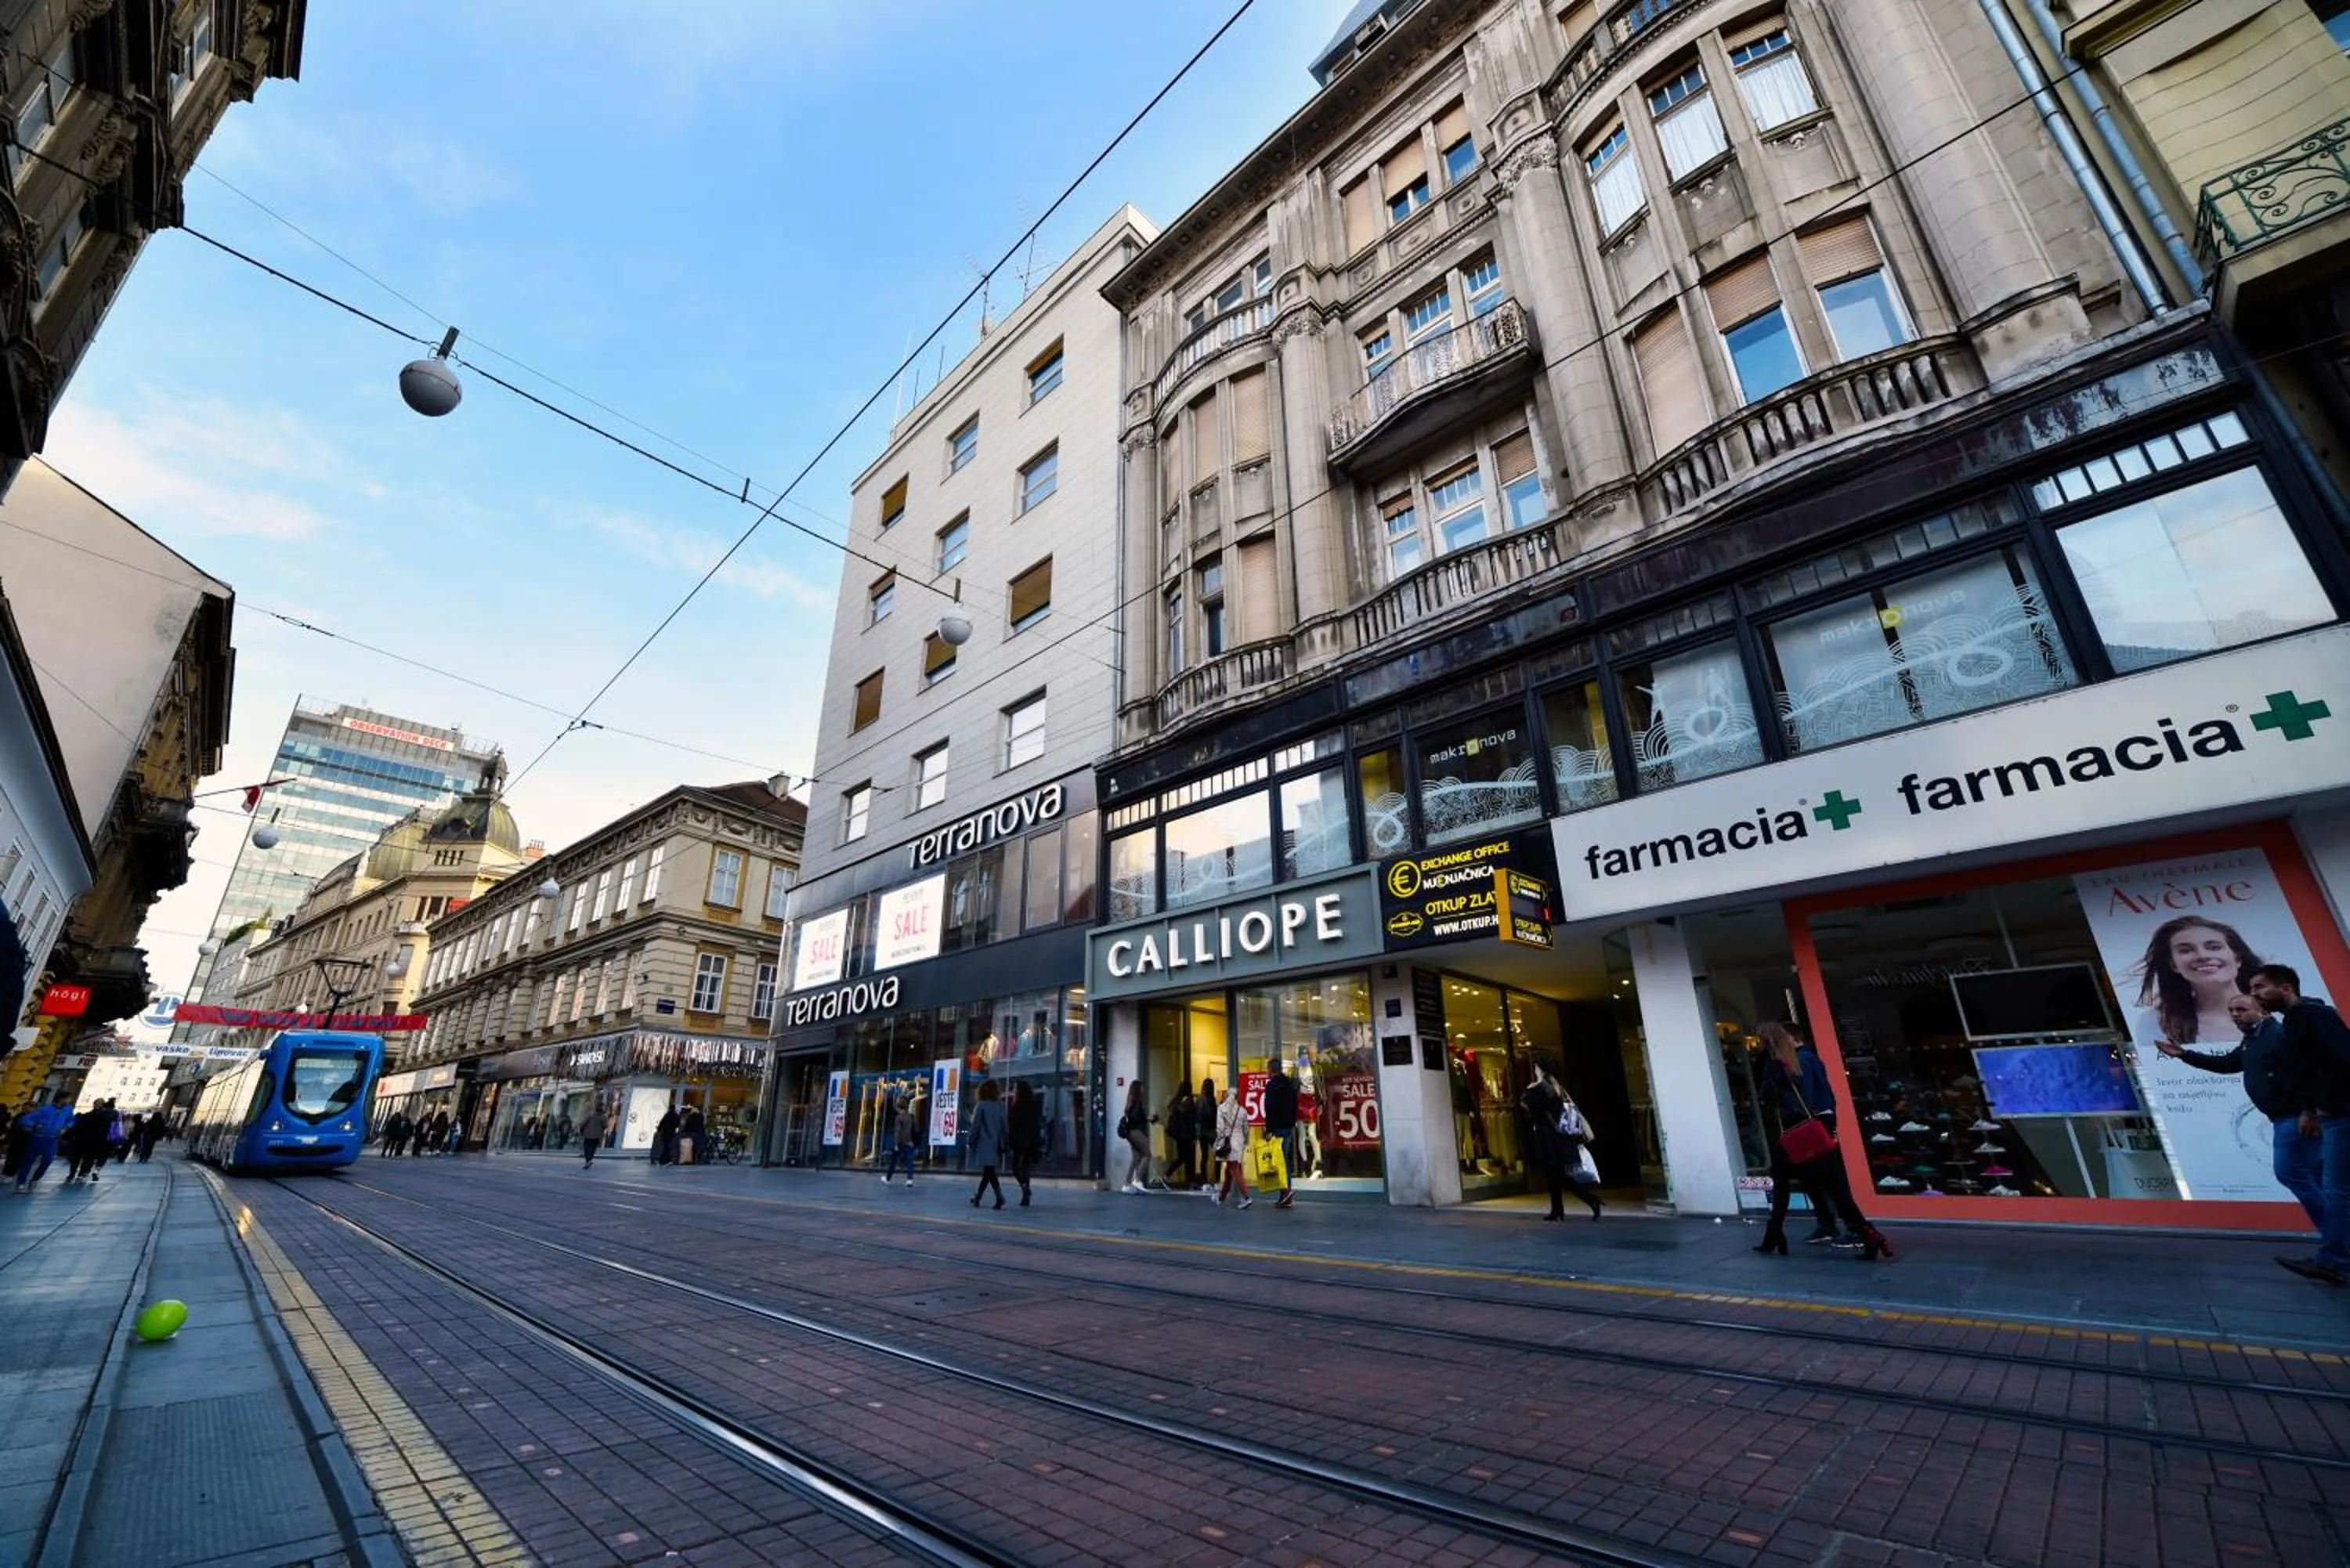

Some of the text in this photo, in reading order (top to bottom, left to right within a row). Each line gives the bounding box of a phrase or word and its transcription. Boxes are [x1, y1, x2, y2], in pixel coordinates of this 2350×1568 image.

[1430, 728, 1516, 765] makronova
[1421, 841, 1510, 870] EXCHANGE OFFICE
[1425, 896, 1467, 915] OTKUP
[2109, 880, 2254, 916] Avène
[894, 905, 929, 941] SALE
[1107, 892, 1343, 977] CALLIOPE
[810, 934, 838, 964] SALE
[1343, 1083, 1376, 1097] SALE
